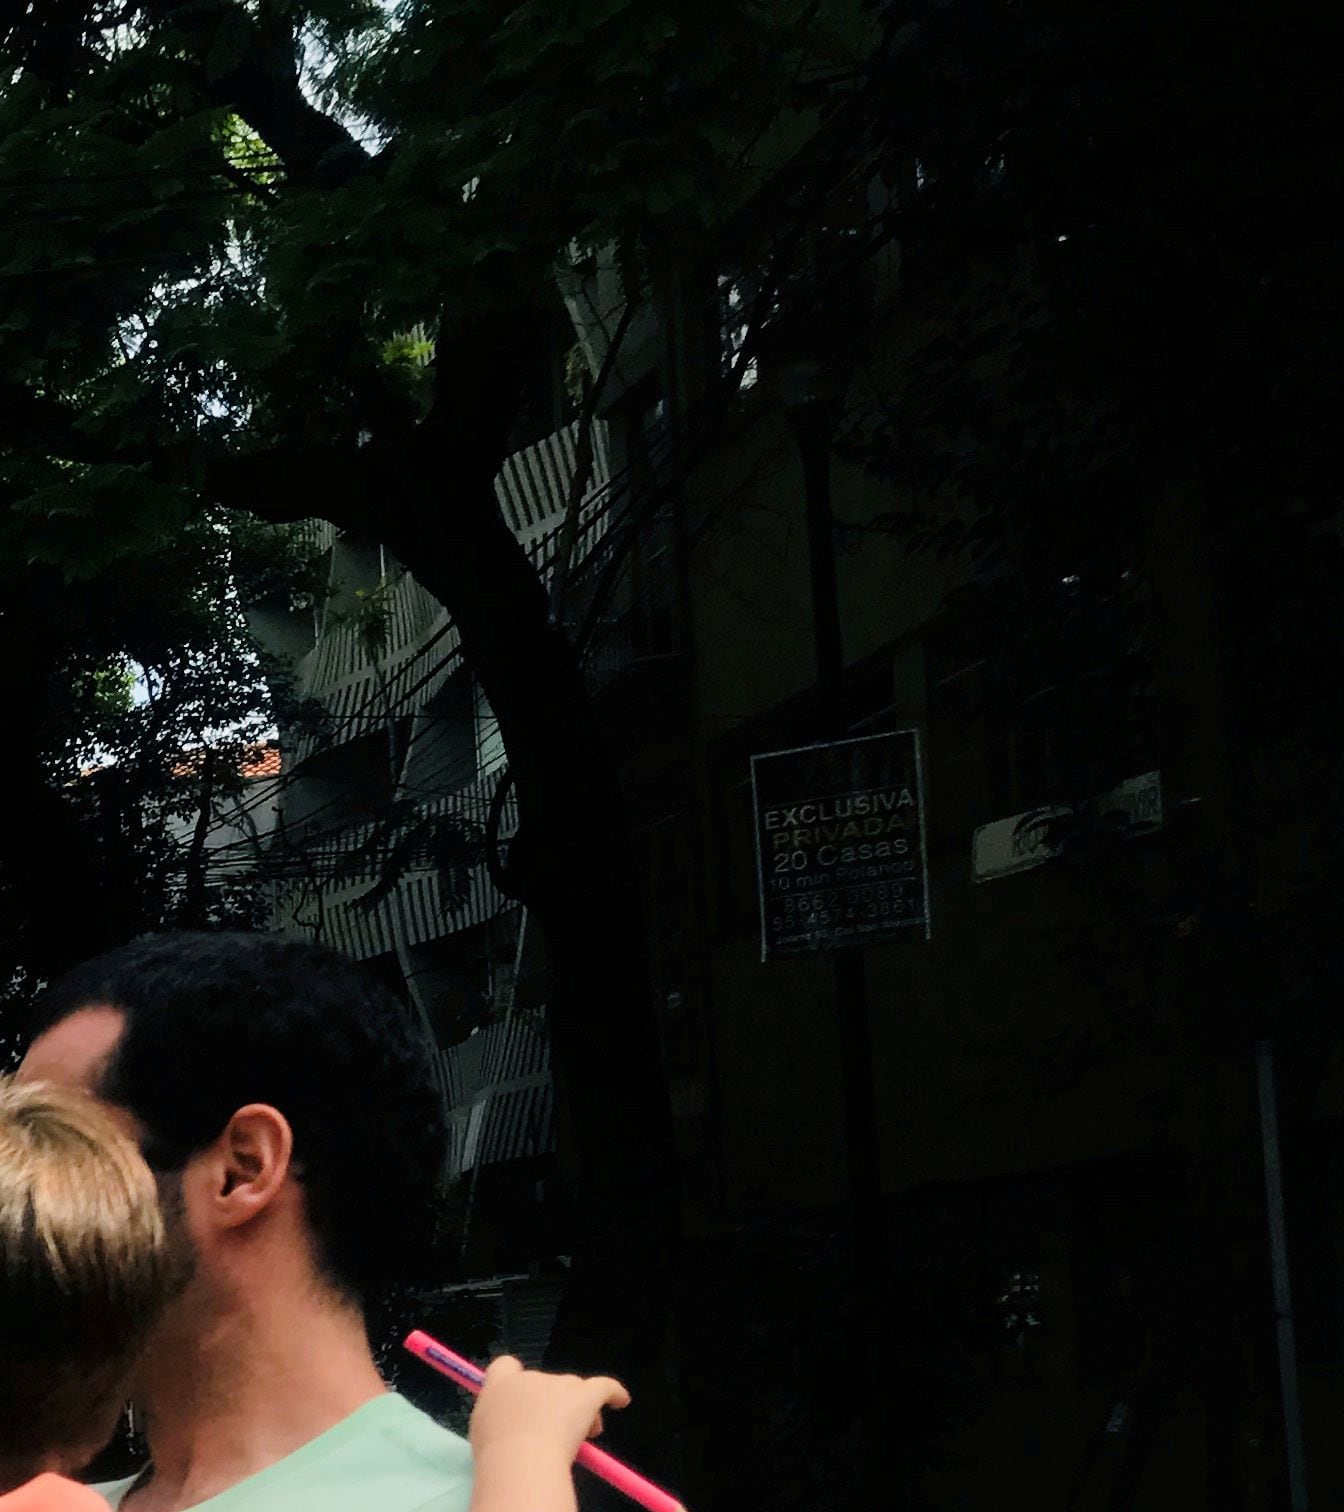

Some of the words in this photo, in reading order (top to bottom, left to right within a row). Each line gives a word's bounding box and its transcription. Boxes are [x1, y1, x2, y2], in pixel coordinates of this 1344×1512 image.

[764, 788, 916, 831] EXCLUSIVA
[772, 814, 907, 850] PRIVADA
[774, 850, 808, 873] 20
[817, 837, 909, 867] Casas
[795, 872, 831, 888] min
[836, 859, 916, 882] Polanco
